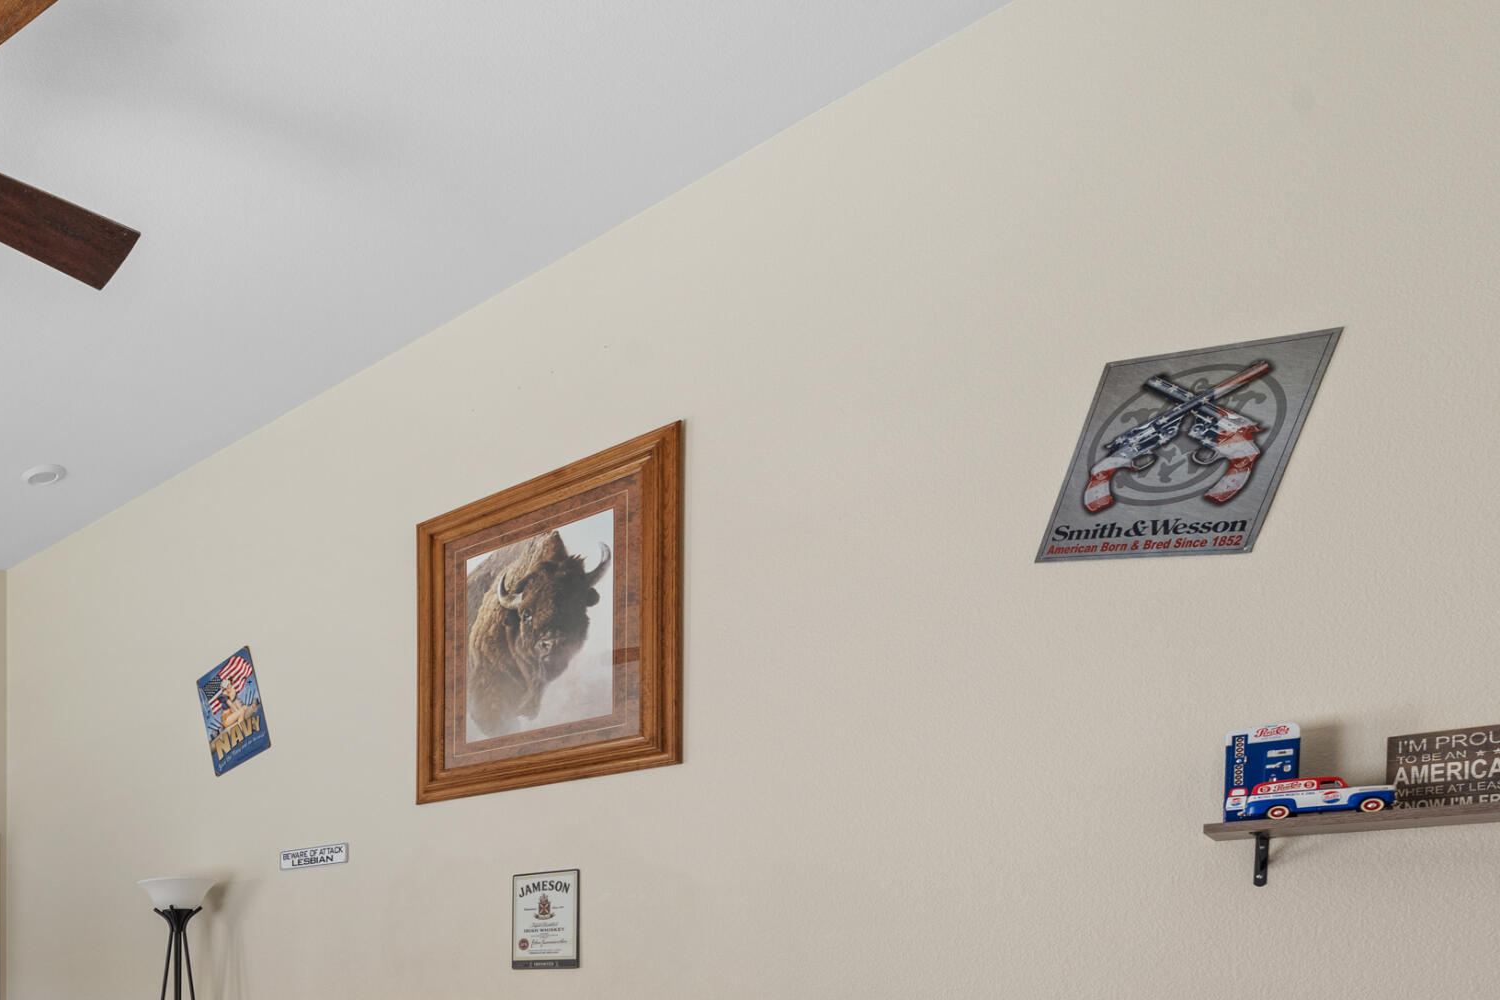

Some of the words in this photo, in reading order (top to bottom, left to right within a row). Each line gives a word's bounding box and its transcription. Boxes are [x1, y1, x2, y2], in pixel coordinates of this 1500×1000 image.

[1047, 544, 1097, 555] American
[1100, 541, 1128, 553] Born
[1130, 541, 1140, 551] &
[1143, 538, 1171, 550] Bred
[1174, 536, 1208, 548] Since
[1212, 534, 1244, 547] 1852
[215, 715, 260, 761] NAVY
[1399, 738, 1427, 753] I'M
[1435, 730, 1500, 749] PROU
[1396, 755, 1417, 764] TO
[1421, 753, 1442, 762] BE
[1445, 750, 1467, 760] AN
[1393, 757, 1500, 785] AMERICA
[1447, 783, 1466, 793] AT
[283, 851, 308, 860] BEWARE
[310, 849, 318, 857] OF
[319, 846, 343, 855] ATTACK
[292, 855, 334, 866] LESBIAN
[519, 880, 570, 898] JAMESON
